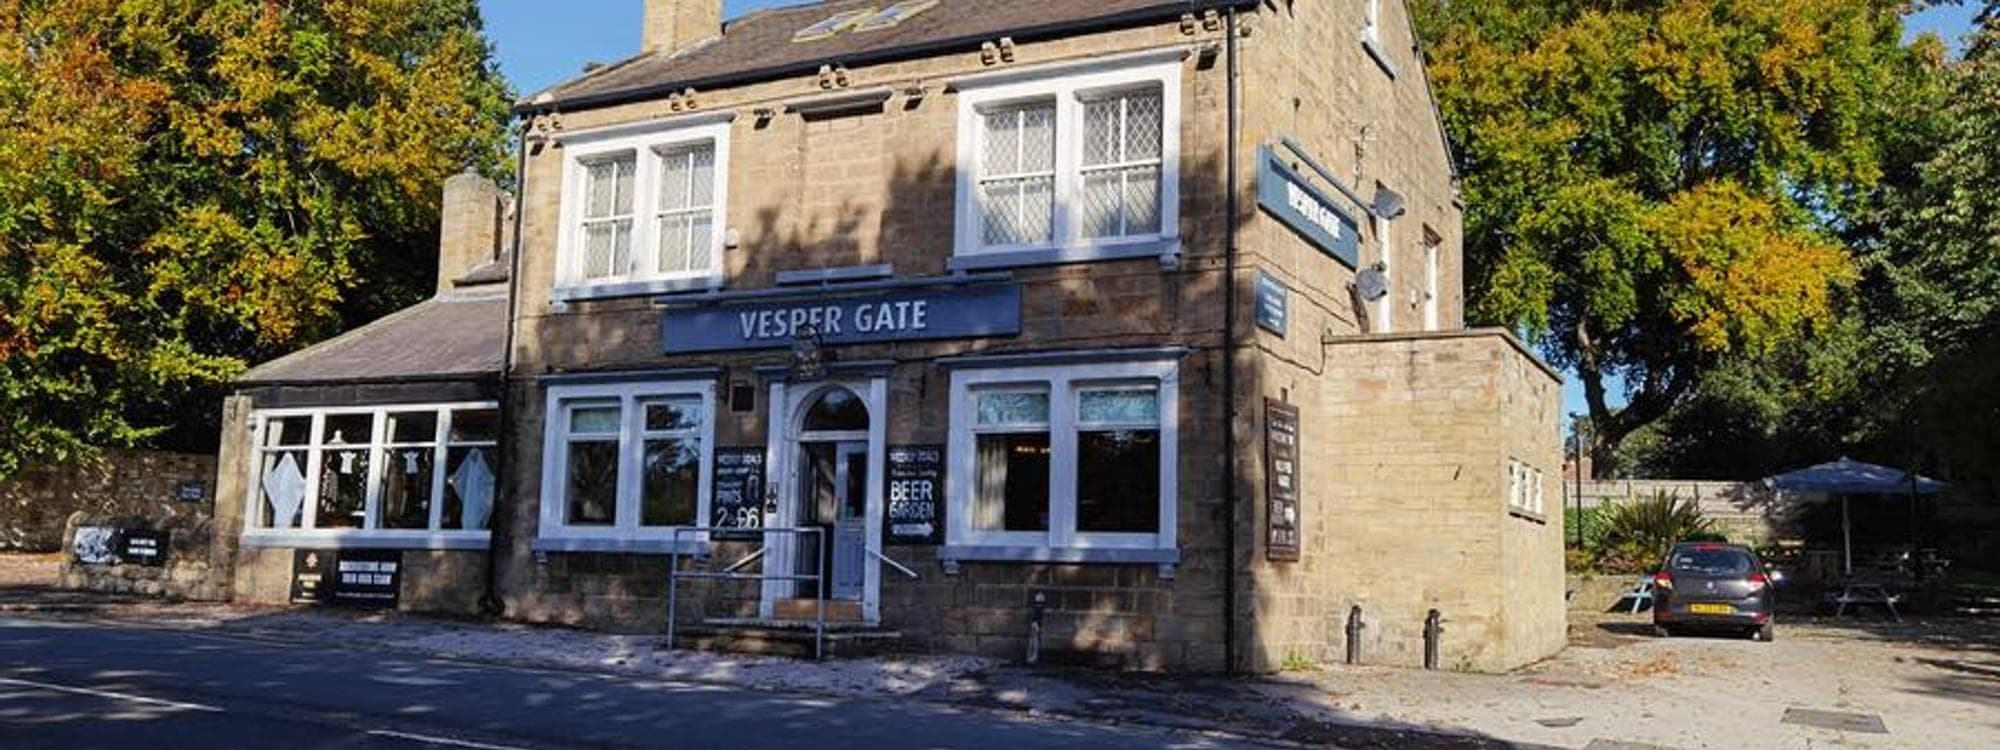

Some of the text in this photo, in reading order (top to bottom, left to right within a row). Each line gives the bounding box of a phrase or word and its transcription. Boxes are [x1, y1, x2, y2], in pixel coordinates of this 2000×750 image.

[740, 300, 926, 339] VESPER GATE
[891, 480, 933, 501] BEER
[716, 507, 728, 529] 2
[889, 501, 935, 519] GARDEN
